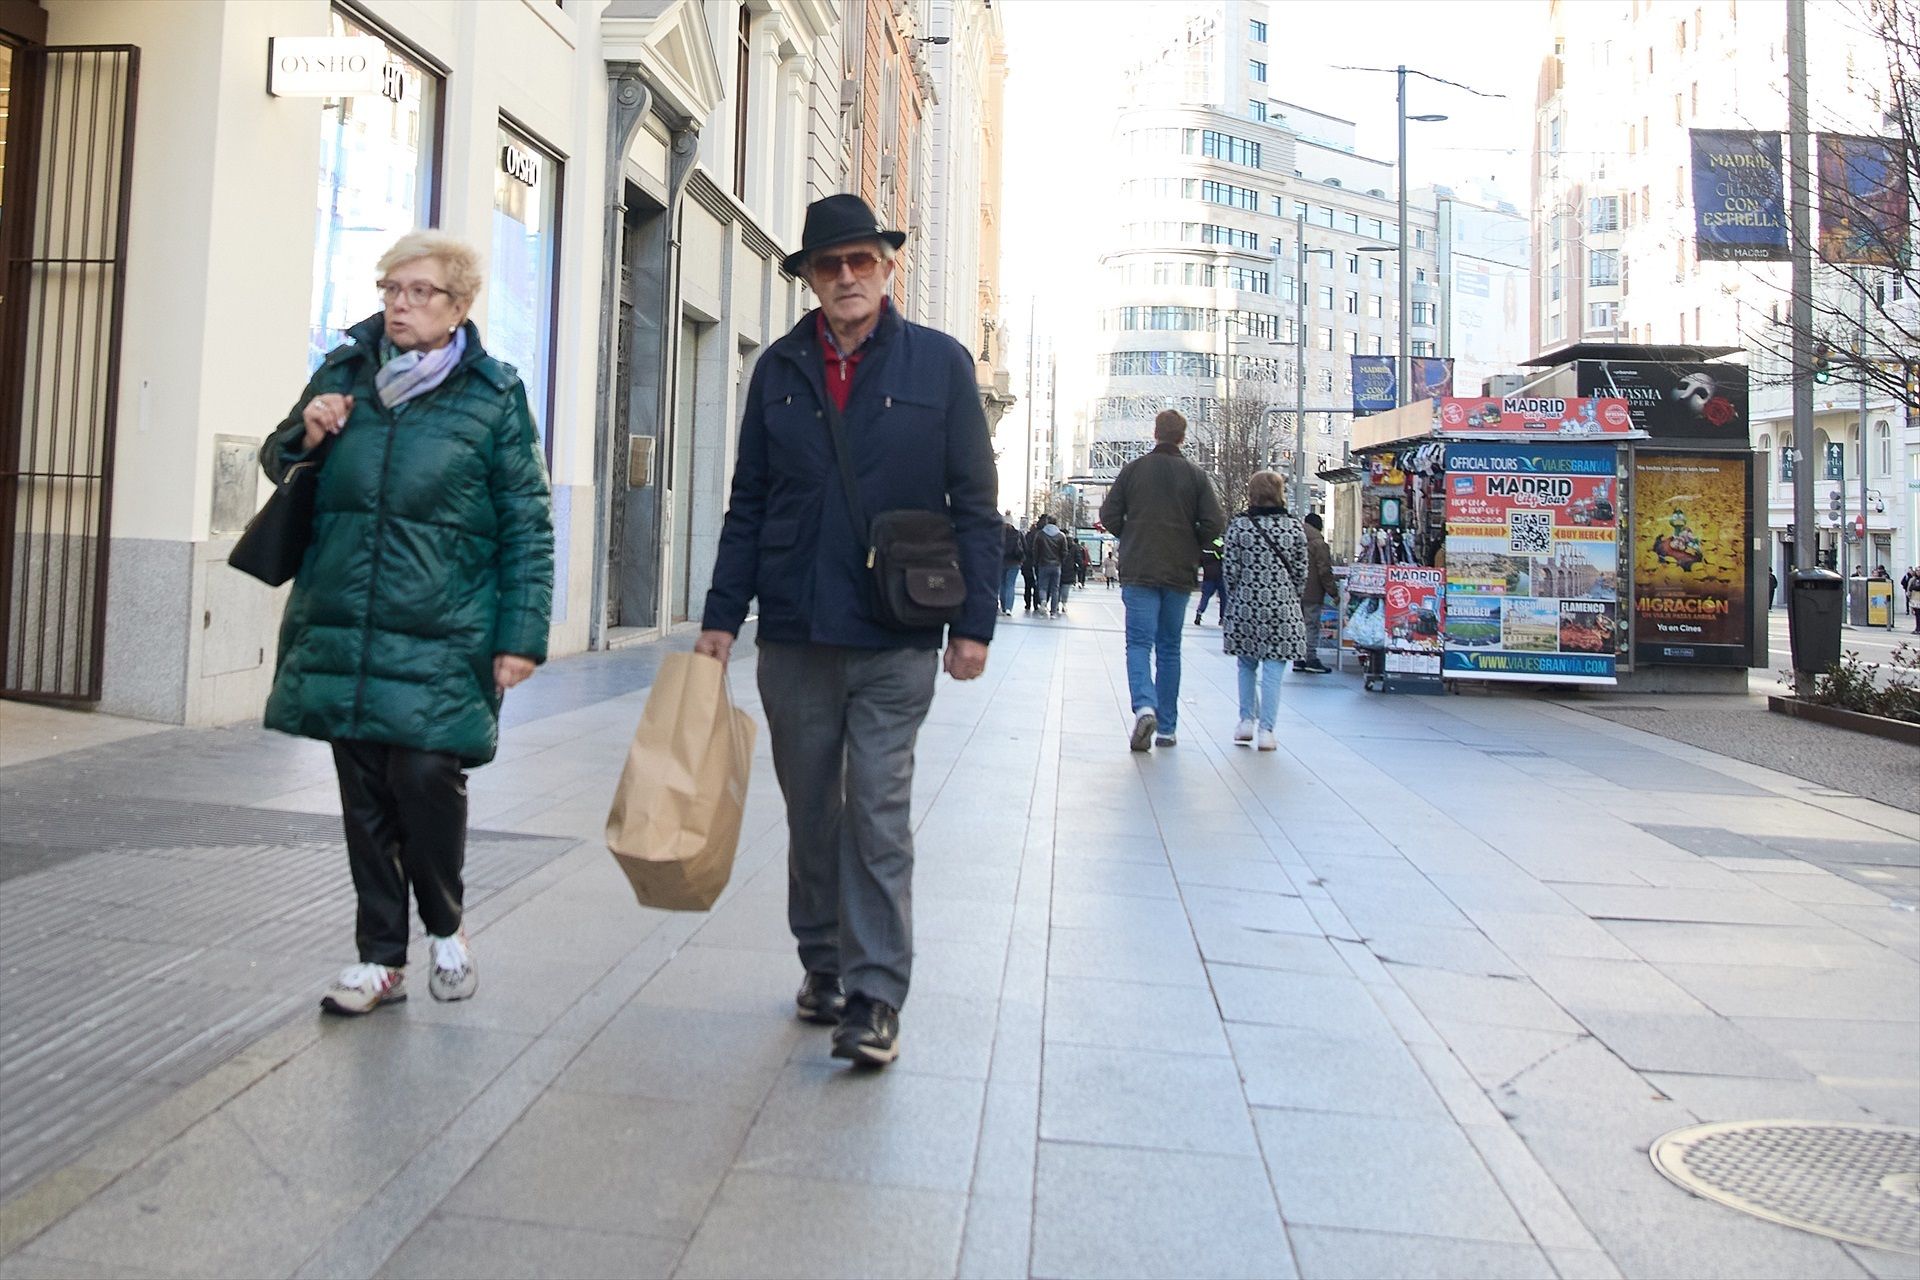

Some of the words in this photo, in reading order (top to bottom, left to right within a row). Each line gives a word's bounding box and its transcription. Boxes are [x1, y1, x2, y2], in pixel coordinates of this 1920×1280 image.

[281, 55, 366, 73] OYSHO
[502, 146, 540, 187] OYSHO
[1724, 197, 1759, 212] CON
[1703, 212, 1779, 228] ESTRELLA
[1734, 248, 1769, 258] MADRID
[1503, 398, 1566, 413] MADRID
[1450, 456, 1489, 470] OFFICIAL
[1490, 457, 1518, 471] TOURS
[1487, 476, 1573, 497] MADRID
[1515, 492, 1538, 508] City
[1539, 492, 1569, 506] Tour
[1455, 527, 1482, 536] COMPRA
[1560, 530, 1577, 539] BUY
[1579, 531, 1600, 541] HERE
[1389, 570, 1442, 583] MADRID
[1561, 602, 1605, 614] FLAMENCO
[1635, 596, 1729, 614] MIGRACIÓN
[1657, 623, 1668, 632] Ya
